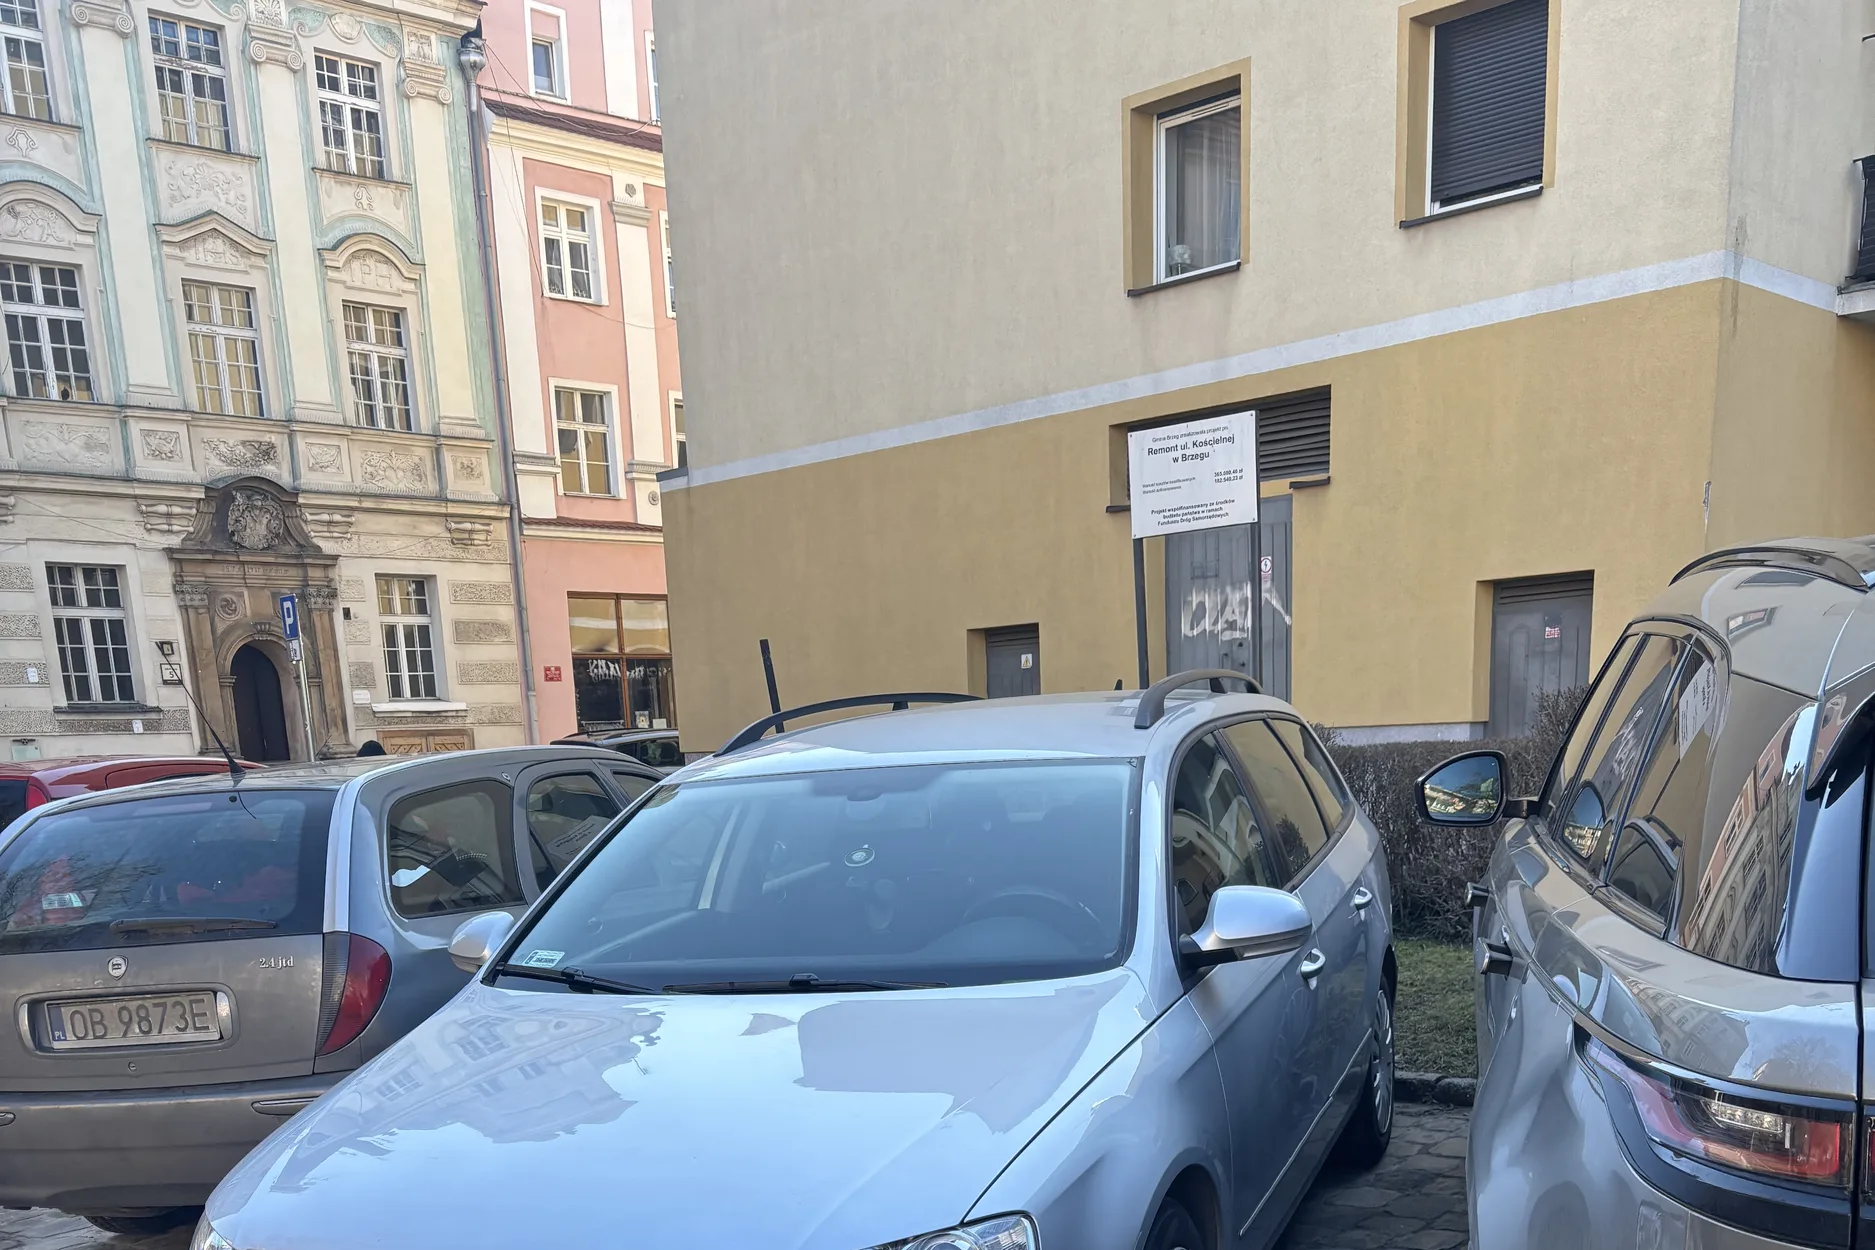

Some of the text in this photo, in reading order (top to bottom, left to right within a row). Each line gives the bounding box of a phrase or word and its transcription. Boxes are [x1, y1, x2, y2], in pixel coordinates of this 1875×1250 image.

[1207, 426, 1222, 435] projekt
[1147, 433, 1235, 456] Remont ul. Kościelnej
[1172, 451, 1210, 464] w Brzegu
[283, 601, 294, 634] P
[259, 955, 294, 970] 2.4 jtd
[69, 998, 211, 1041] OB 9873E
[54, 1031, 66, 1041] PL
